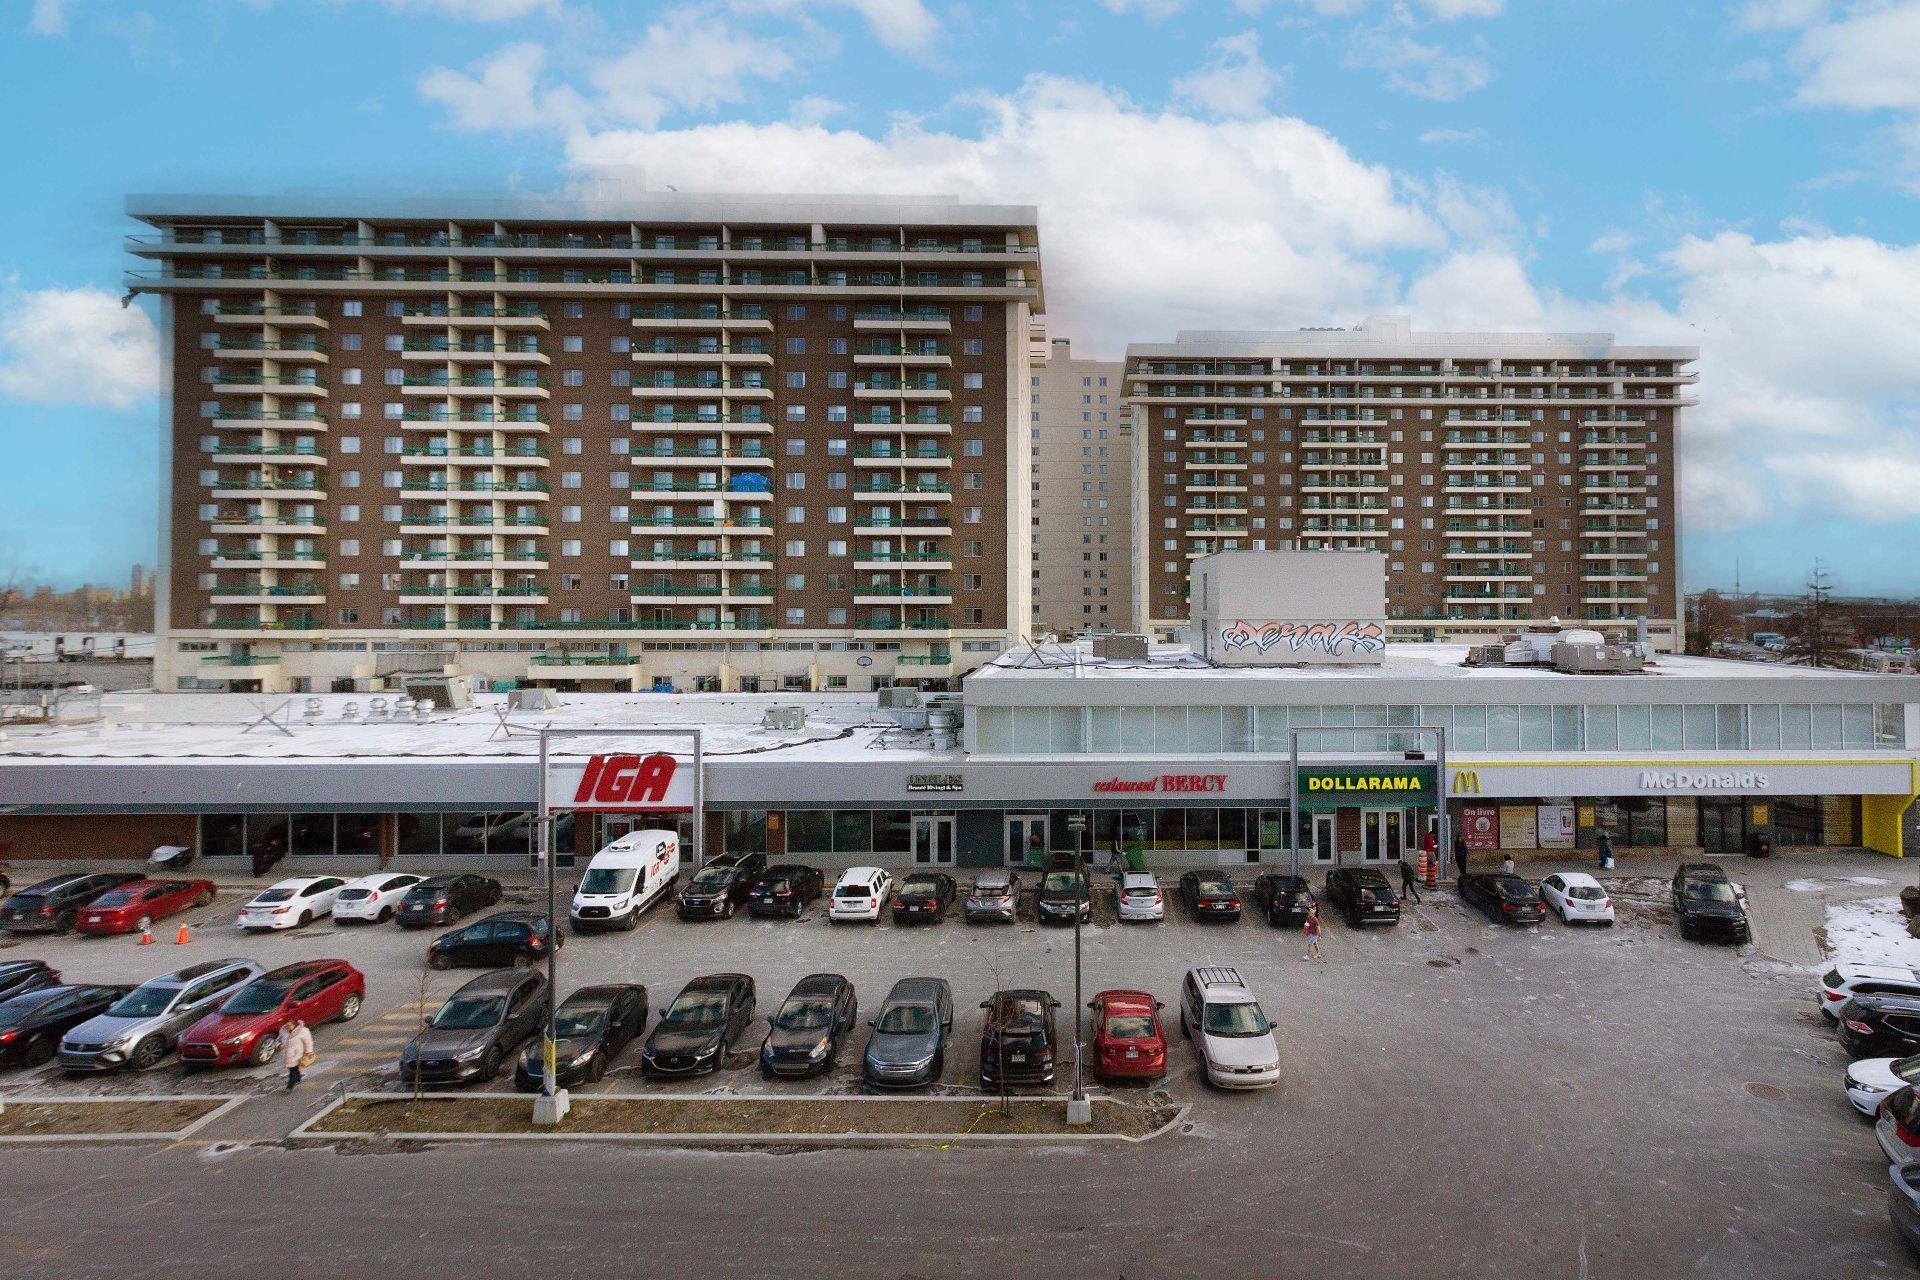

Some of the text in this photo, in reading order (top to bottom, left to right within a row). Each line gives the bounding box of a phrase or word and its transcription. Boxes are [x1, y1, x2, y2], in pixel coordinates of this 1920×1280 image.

[574, 755, 677, 802] IGA
[1093, 775, 1228, 792] restaurant BERCY
[1308, 777, 1421, 790] DOLLARAMA
[1640, 771, 1770, 789] McDonald's
[1477, 808, 1495, 816] livre
